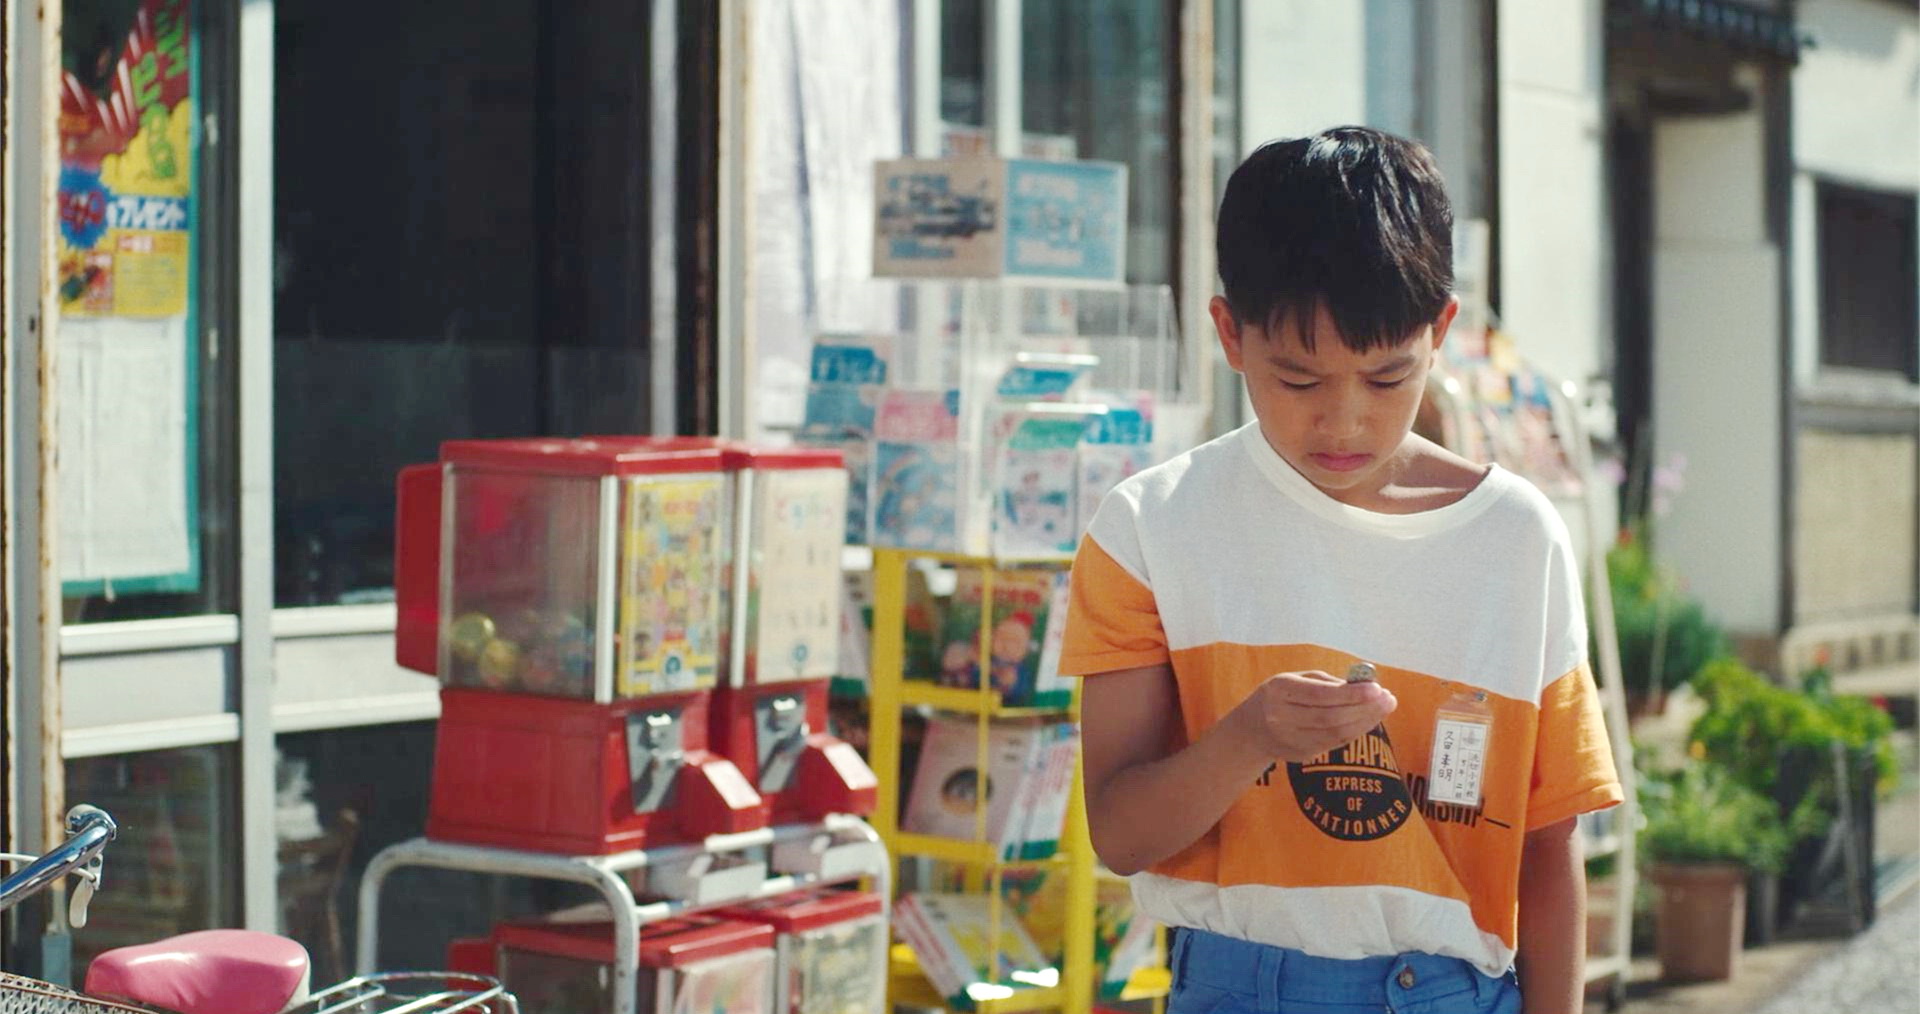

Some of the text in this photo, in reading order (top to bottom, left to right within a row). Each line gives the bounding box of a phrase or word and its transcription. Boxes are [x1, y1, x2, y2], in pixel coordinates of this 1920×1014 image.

[1326, 776, 1383, 794] EXPRESS
[1346, 796, 1363, 812] OF
[1303, 796, 1406, 836] STATIONNER
